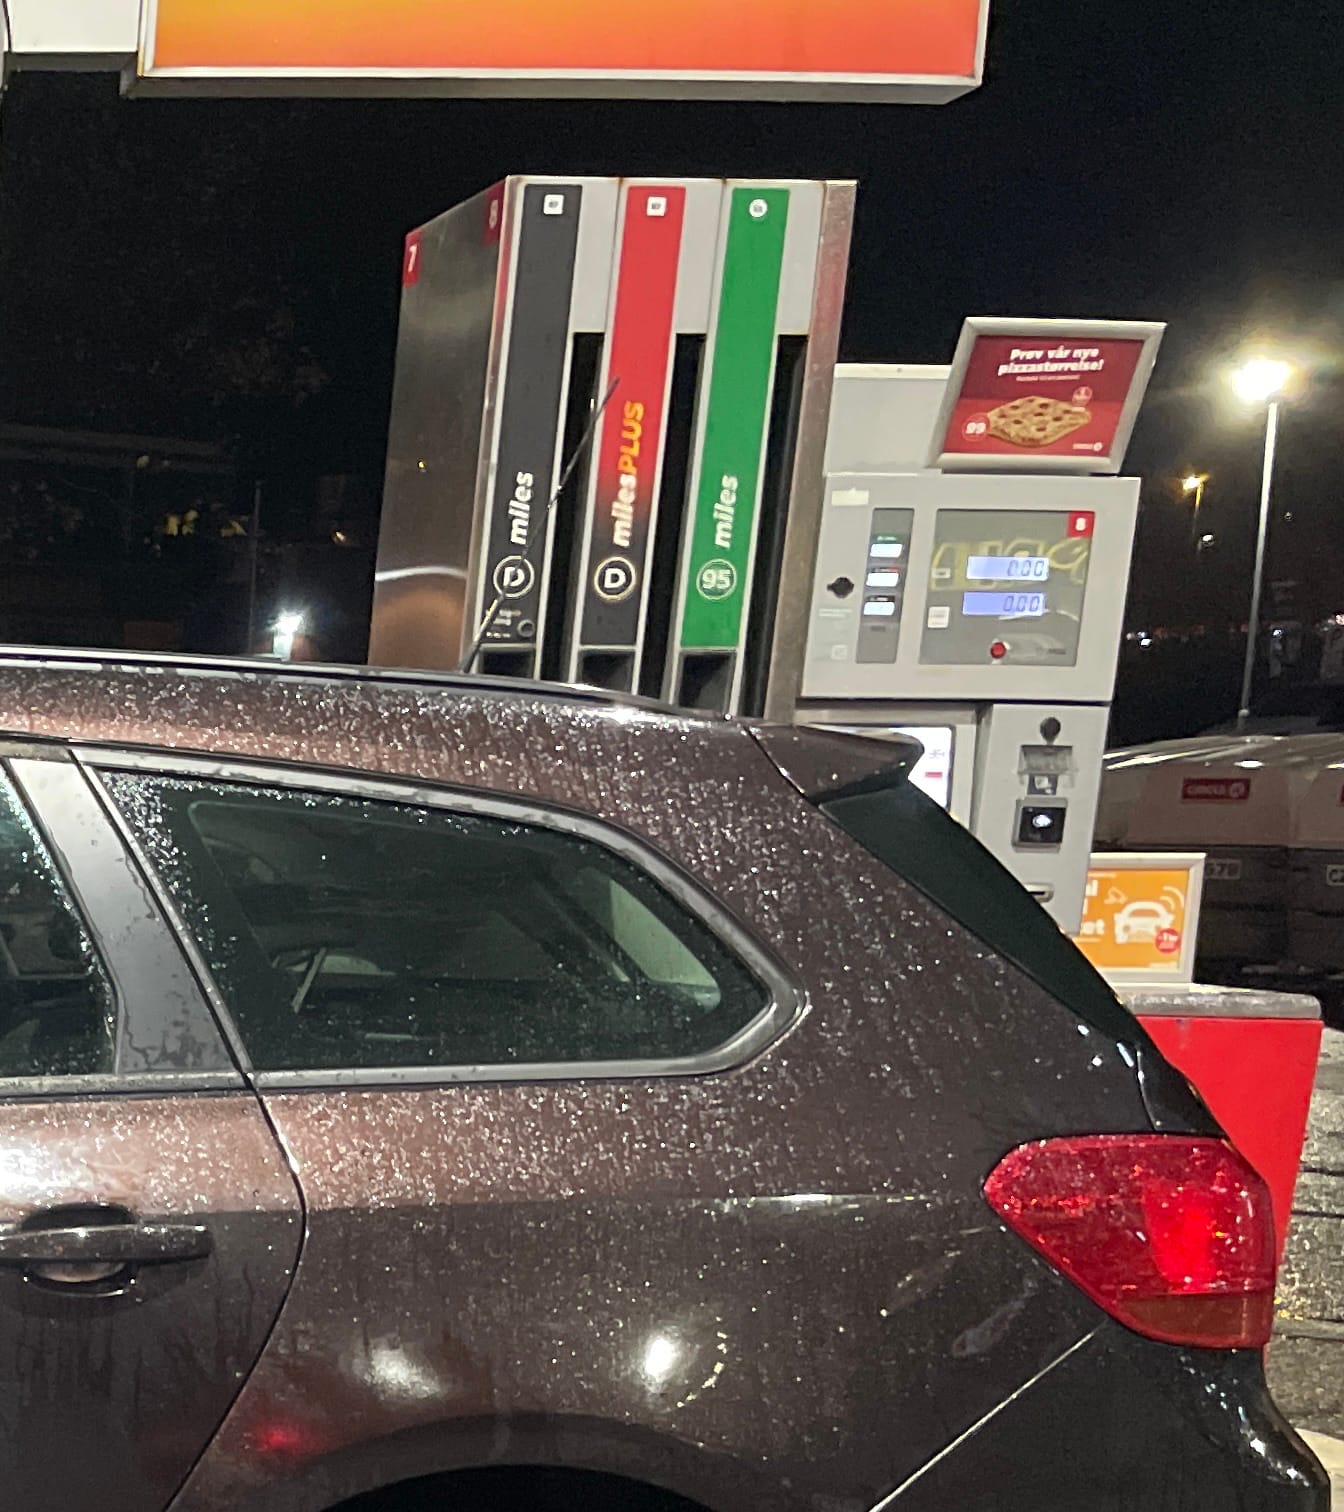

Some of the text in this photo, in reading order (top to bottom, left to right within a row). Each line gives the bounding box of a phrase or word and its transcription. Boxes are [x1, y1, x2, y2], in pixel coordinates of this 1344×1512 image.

[508, 471, 533, 545] miles
[713, 474, 738, 549] miles
[604, 568, 626, 588] D
[702, 568, 731, 590] 95
